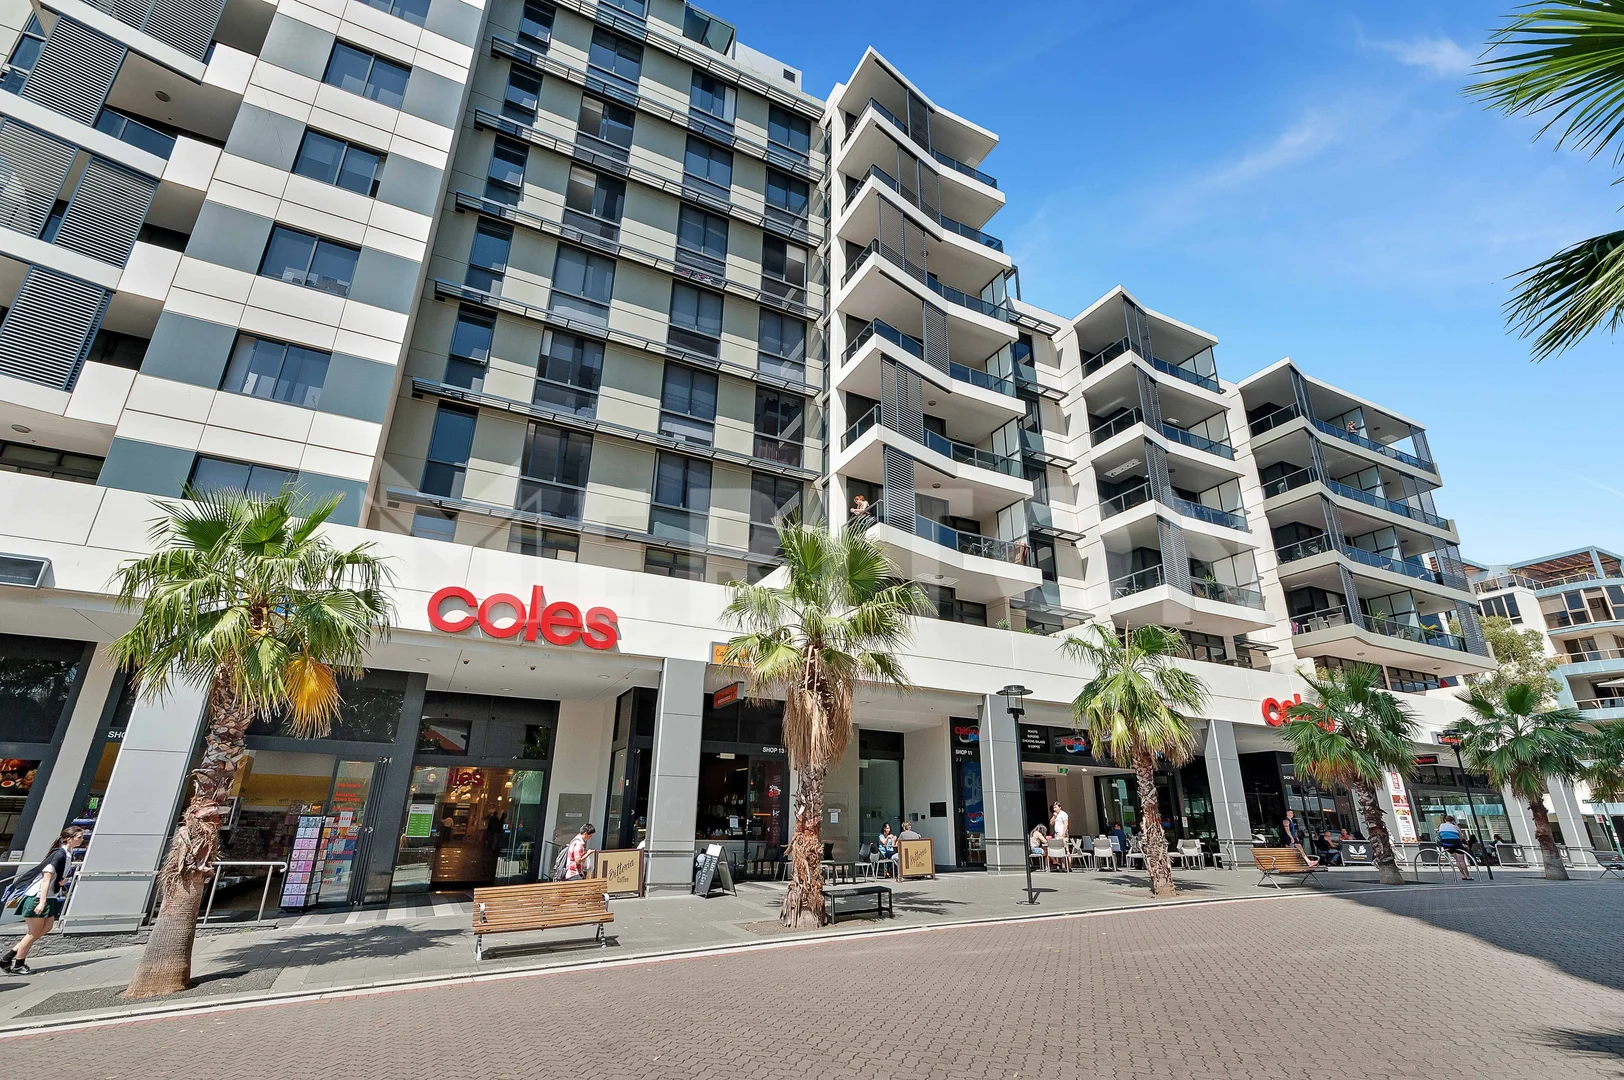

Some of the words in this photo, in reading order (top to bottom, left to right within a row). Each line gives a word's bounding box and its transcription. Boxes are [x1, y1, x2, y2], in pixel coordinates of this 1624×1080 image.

[427, 584, 619, 650] coles
[762, 746, 777, 754] SHOP
[424, 767, 484, 786] coles
